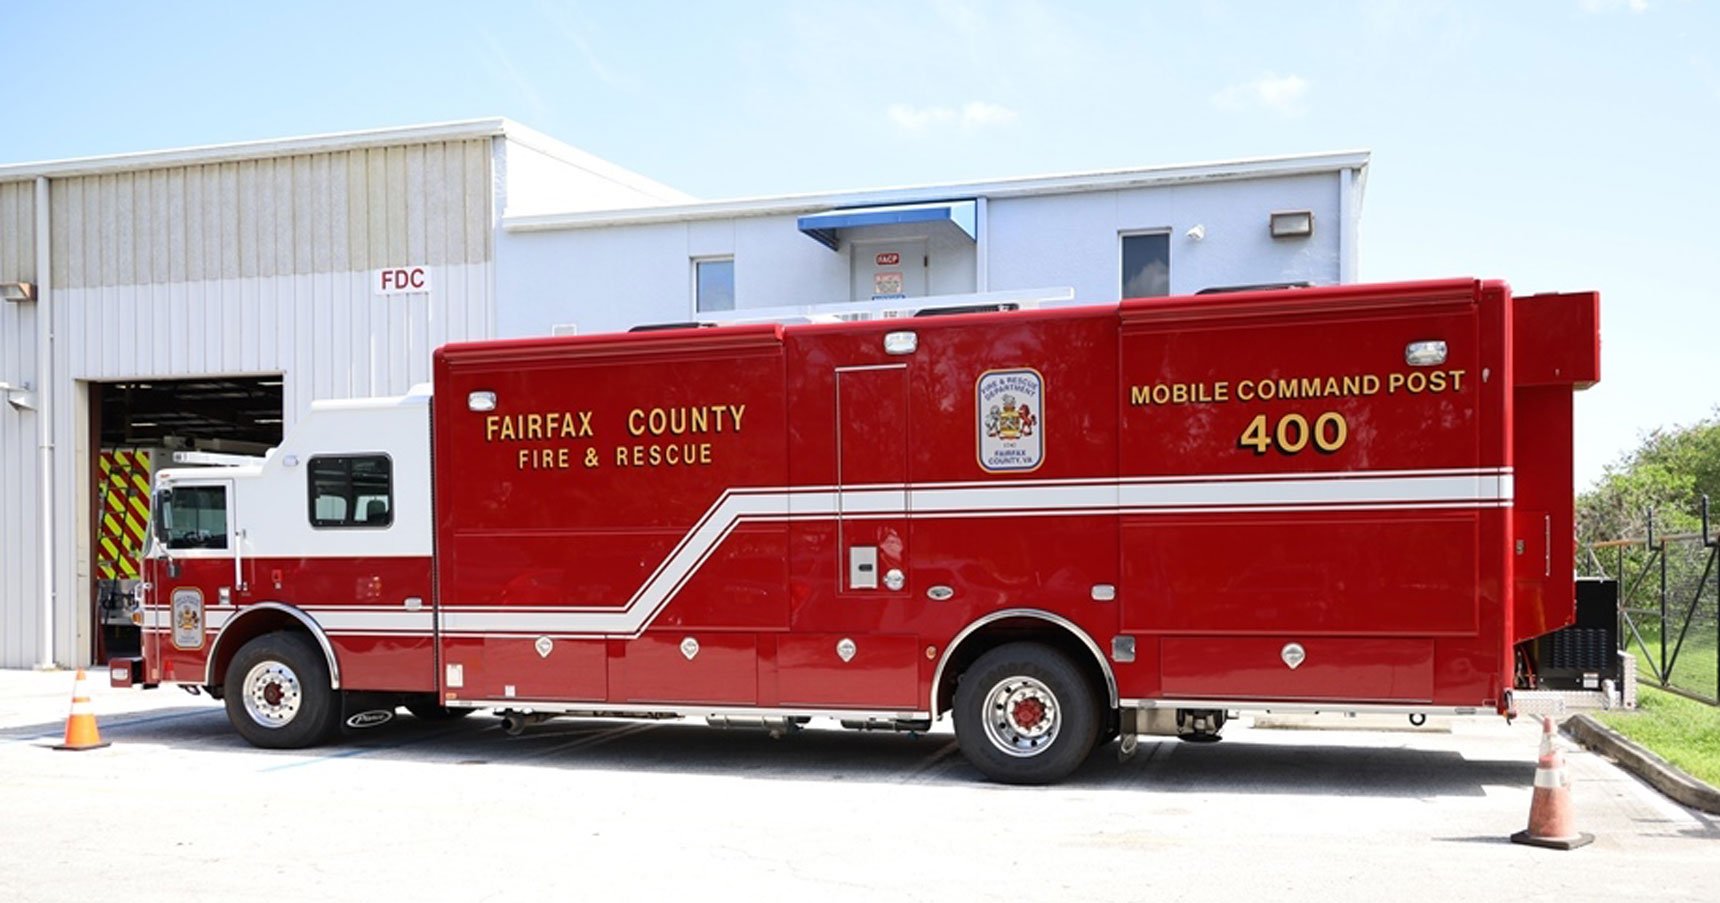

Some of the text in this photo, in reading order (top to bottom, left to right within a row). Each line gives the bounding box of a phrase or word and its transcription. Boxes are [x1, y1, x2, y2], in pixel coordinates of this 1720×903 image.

[381, 268, 425, 290] FDC
[982, 381, 997, 394] FIRE
[1007, 376, 1038, 390] RESCUE
[984, 384, 1036, 401] DEPARTMENT
[1131, 370, 1465, 405] MOBILE COMMAND POST
[486, 404, 746, 441] FAIRFAX COUNTY
[1238, 411, 1348, 455] 400
[519, 443, 712, 469] FIRE & RESCUE
[994, 449, 1026, 457] FAIRFAX
